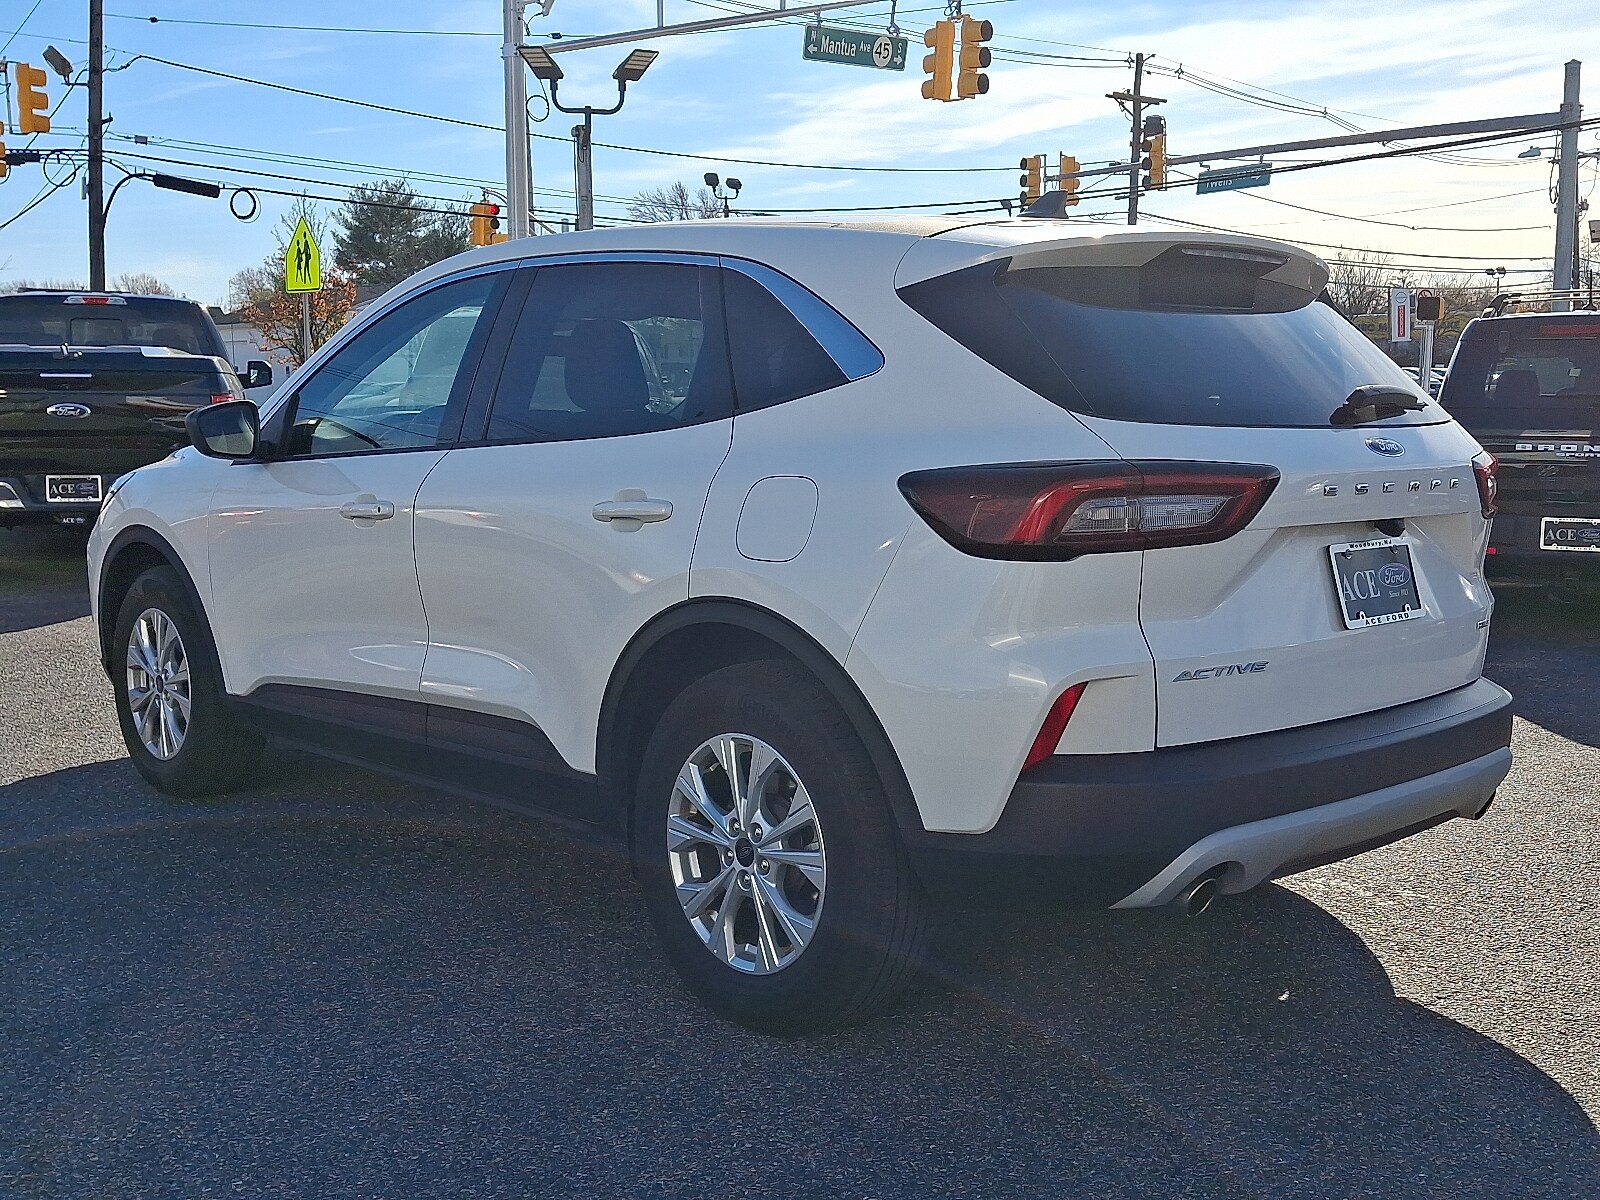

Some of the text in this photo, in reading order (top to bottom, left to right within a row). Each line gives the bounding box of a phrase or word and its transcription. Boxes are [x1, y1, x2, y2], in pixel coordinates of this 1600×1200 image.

[820, 35, 891, 60] Mantua Ave 45
[897, 42, 903, 54] S
[50, 484, 76, 495] ACE
[1323, 478, 1459, 497] ESCAPE
[1545, 528, 1577, 541] ACE
[1342, 569, 1381, 602] ACE
[1365, 612, 1410, 626] ACE FORD
[1172, 661, 1270, 682] ACTIVE
